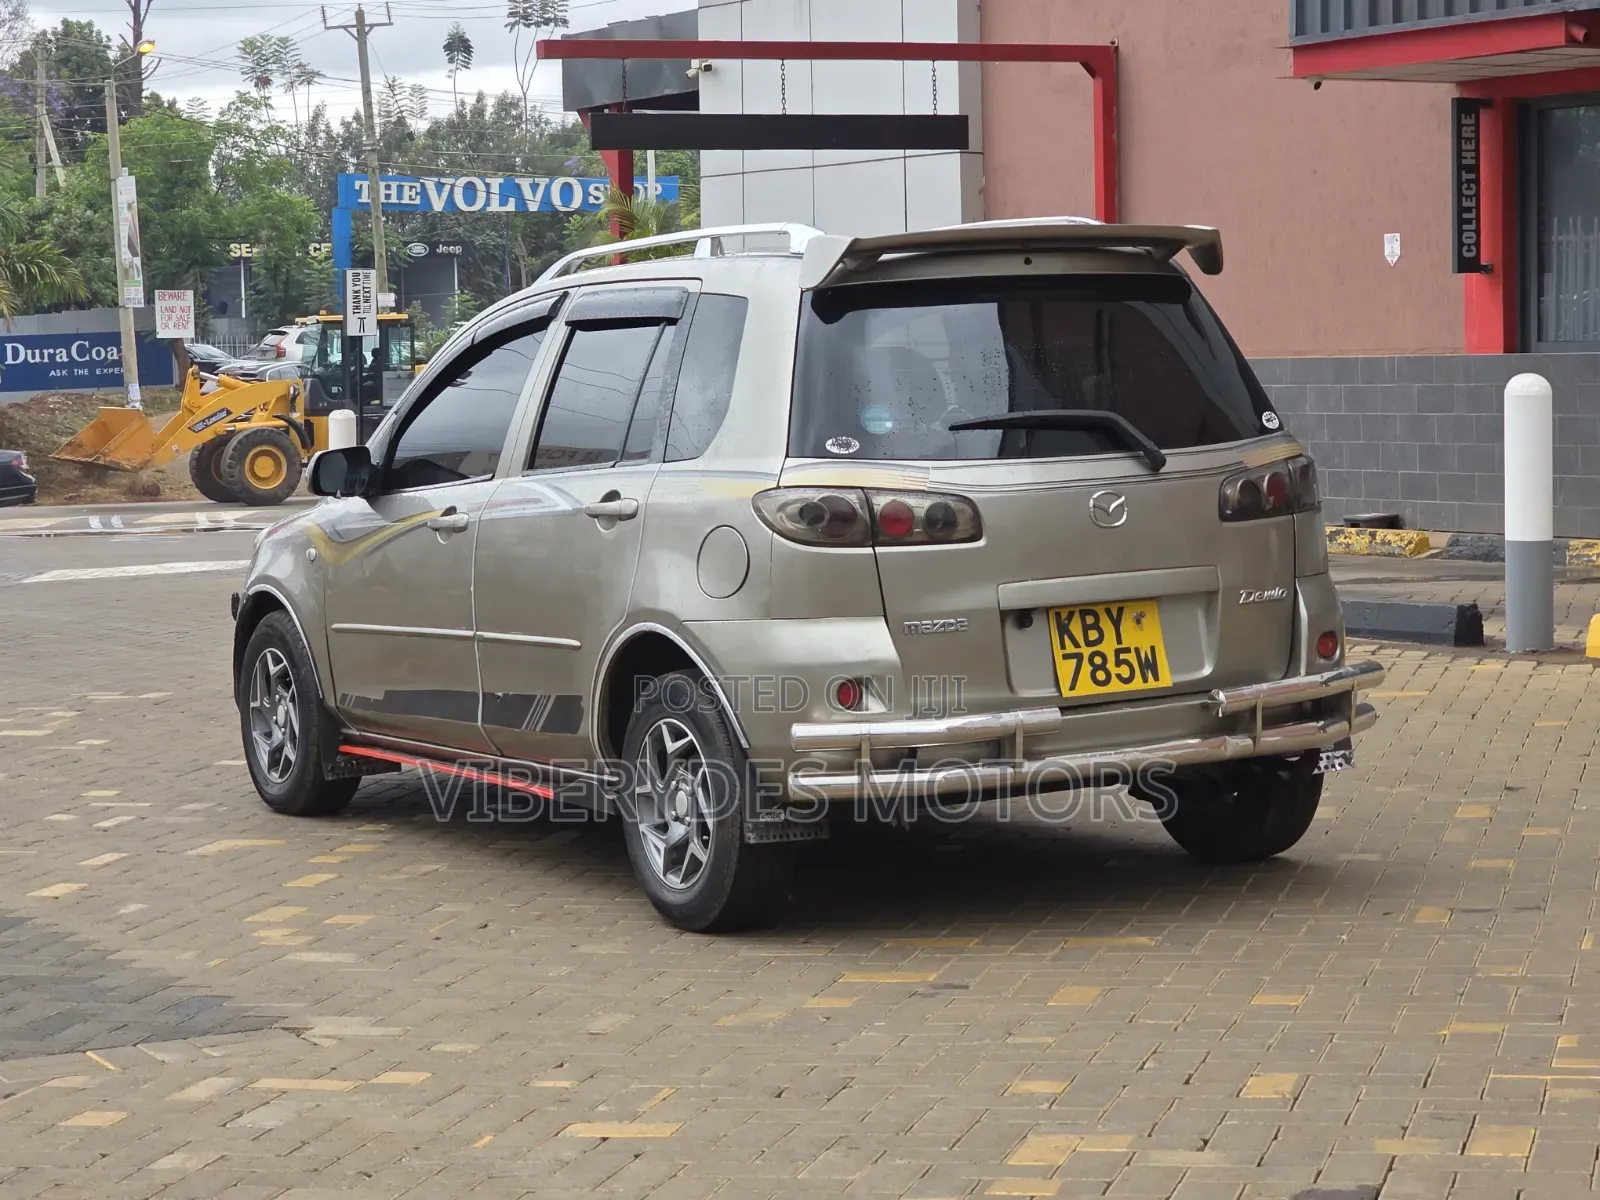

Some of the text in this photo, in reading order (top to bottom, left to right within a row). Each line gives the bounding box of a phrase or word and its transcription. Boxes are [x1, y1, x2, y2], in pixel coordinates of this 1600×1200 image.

[1461, 113, 1477, 257] COLLECT HERE
[354, 176, 663, 212] THE VOLVO SOP
[436, 244, 462, 254] Jeep
[362, 271, 372, 285] TIME
[158, 291, 188, 301] BEWARE
[352, 272, 361, 315] THANK YOU
[362, 285, 372, 304] NEXT
[362, 304, 372, 314] TILL
[161, 314, 191, 322] FOR SALE
[161, 321, 191, 330] OR RENT
[5, 340, 123, 364] DuraCoa
[49, 367, 125, 377] ASK THE EXPER
[1239, 587, 1288, 604] Demio
[1054, 606, 1125, 650] KBY
[1062, 645, 1160, 692] 785W
